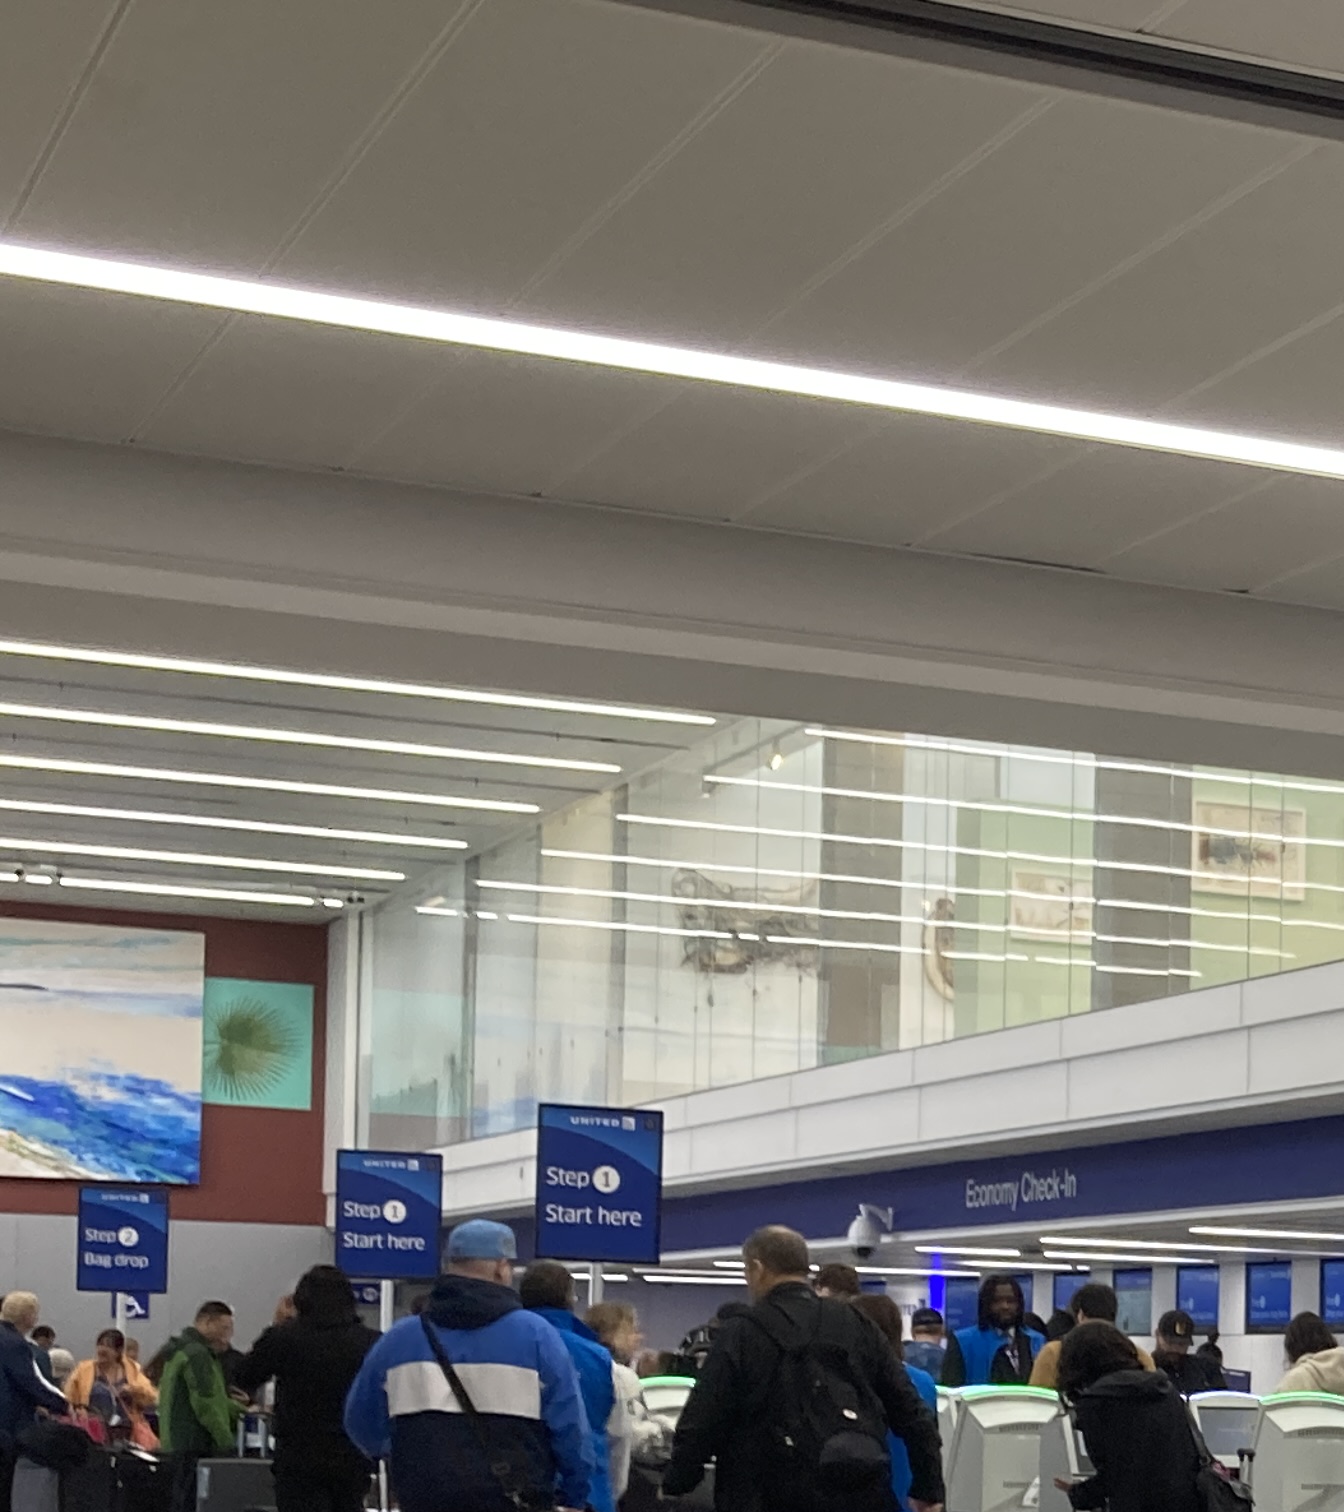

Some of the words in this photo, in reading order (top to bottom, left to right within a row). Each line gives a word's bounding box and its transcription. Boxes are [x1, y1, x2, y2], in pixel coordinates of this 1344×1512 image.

[569, 1116, 620, 1127] UNITED
[363, 1159, 406, 1169] UNITED
[546, 1166, 590, 1190] Step
[966, 1179, 1020, 1212] Economy
[1021, 1168, 1077, 1203] Check-In
[343, 1201, 381, 1220] Step
[545, 1203, 593, 1225] Start
[598, 1205, 642, 1227] here
[85, 1228, 117, 1244] Step
[343, 1231, 383, 1249] Start
[387, 1233, 426, 1251] here
[84, 1251, 112, 1269] Bag
[114, 1253, 150, 1269] drop
